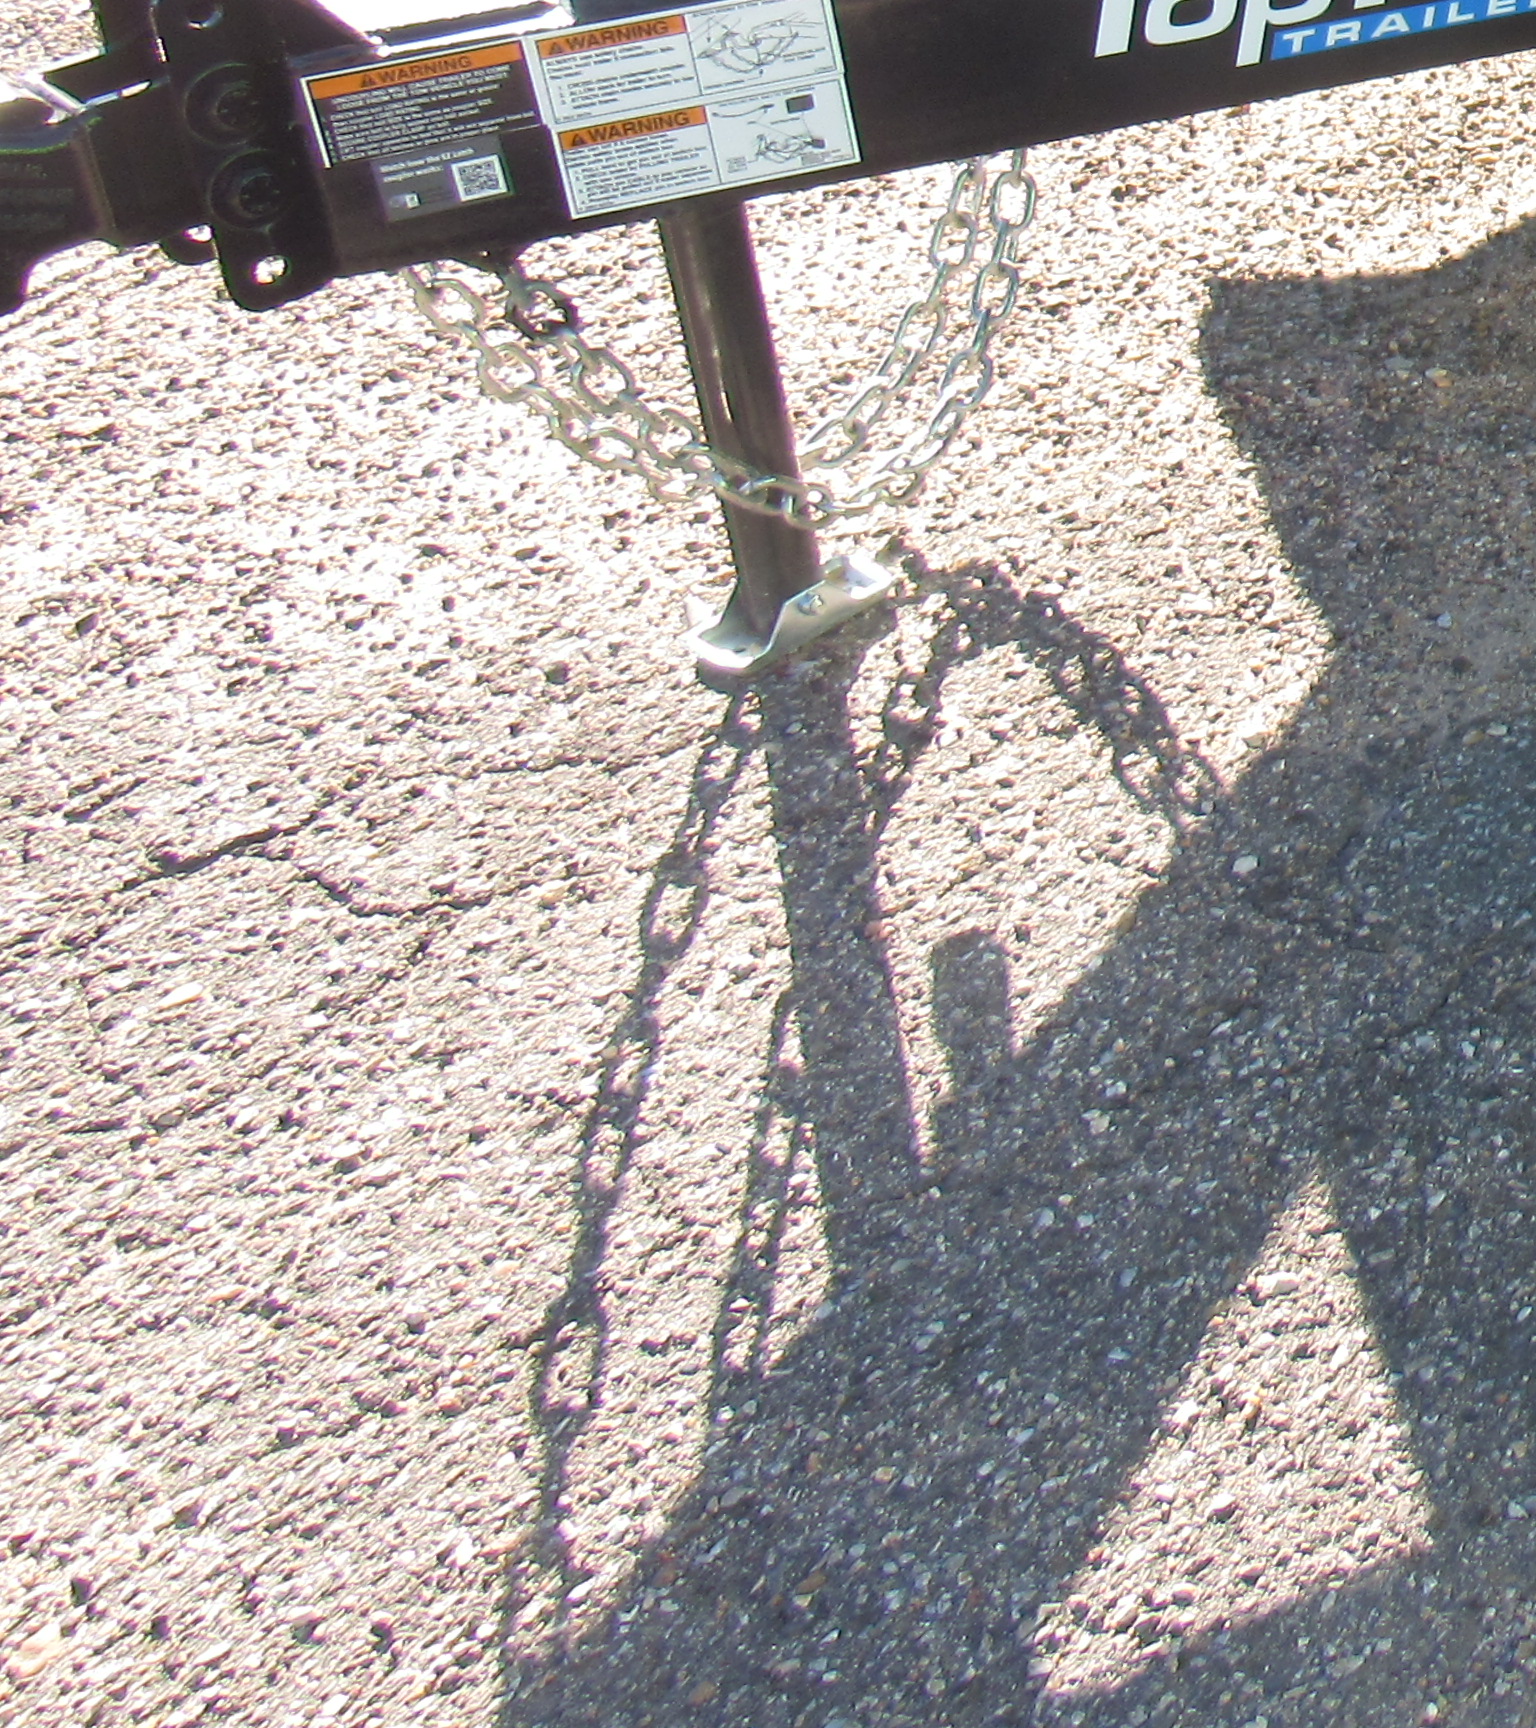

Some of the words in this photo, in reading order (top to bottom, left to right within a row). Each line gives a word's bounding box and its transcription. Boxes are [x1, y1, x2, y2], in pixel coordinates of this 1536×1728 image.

[566, 21, 669, 47] WARNING
[379, 55, 473, 85] WARNING
[588, 112, 690, 142] WARNING
